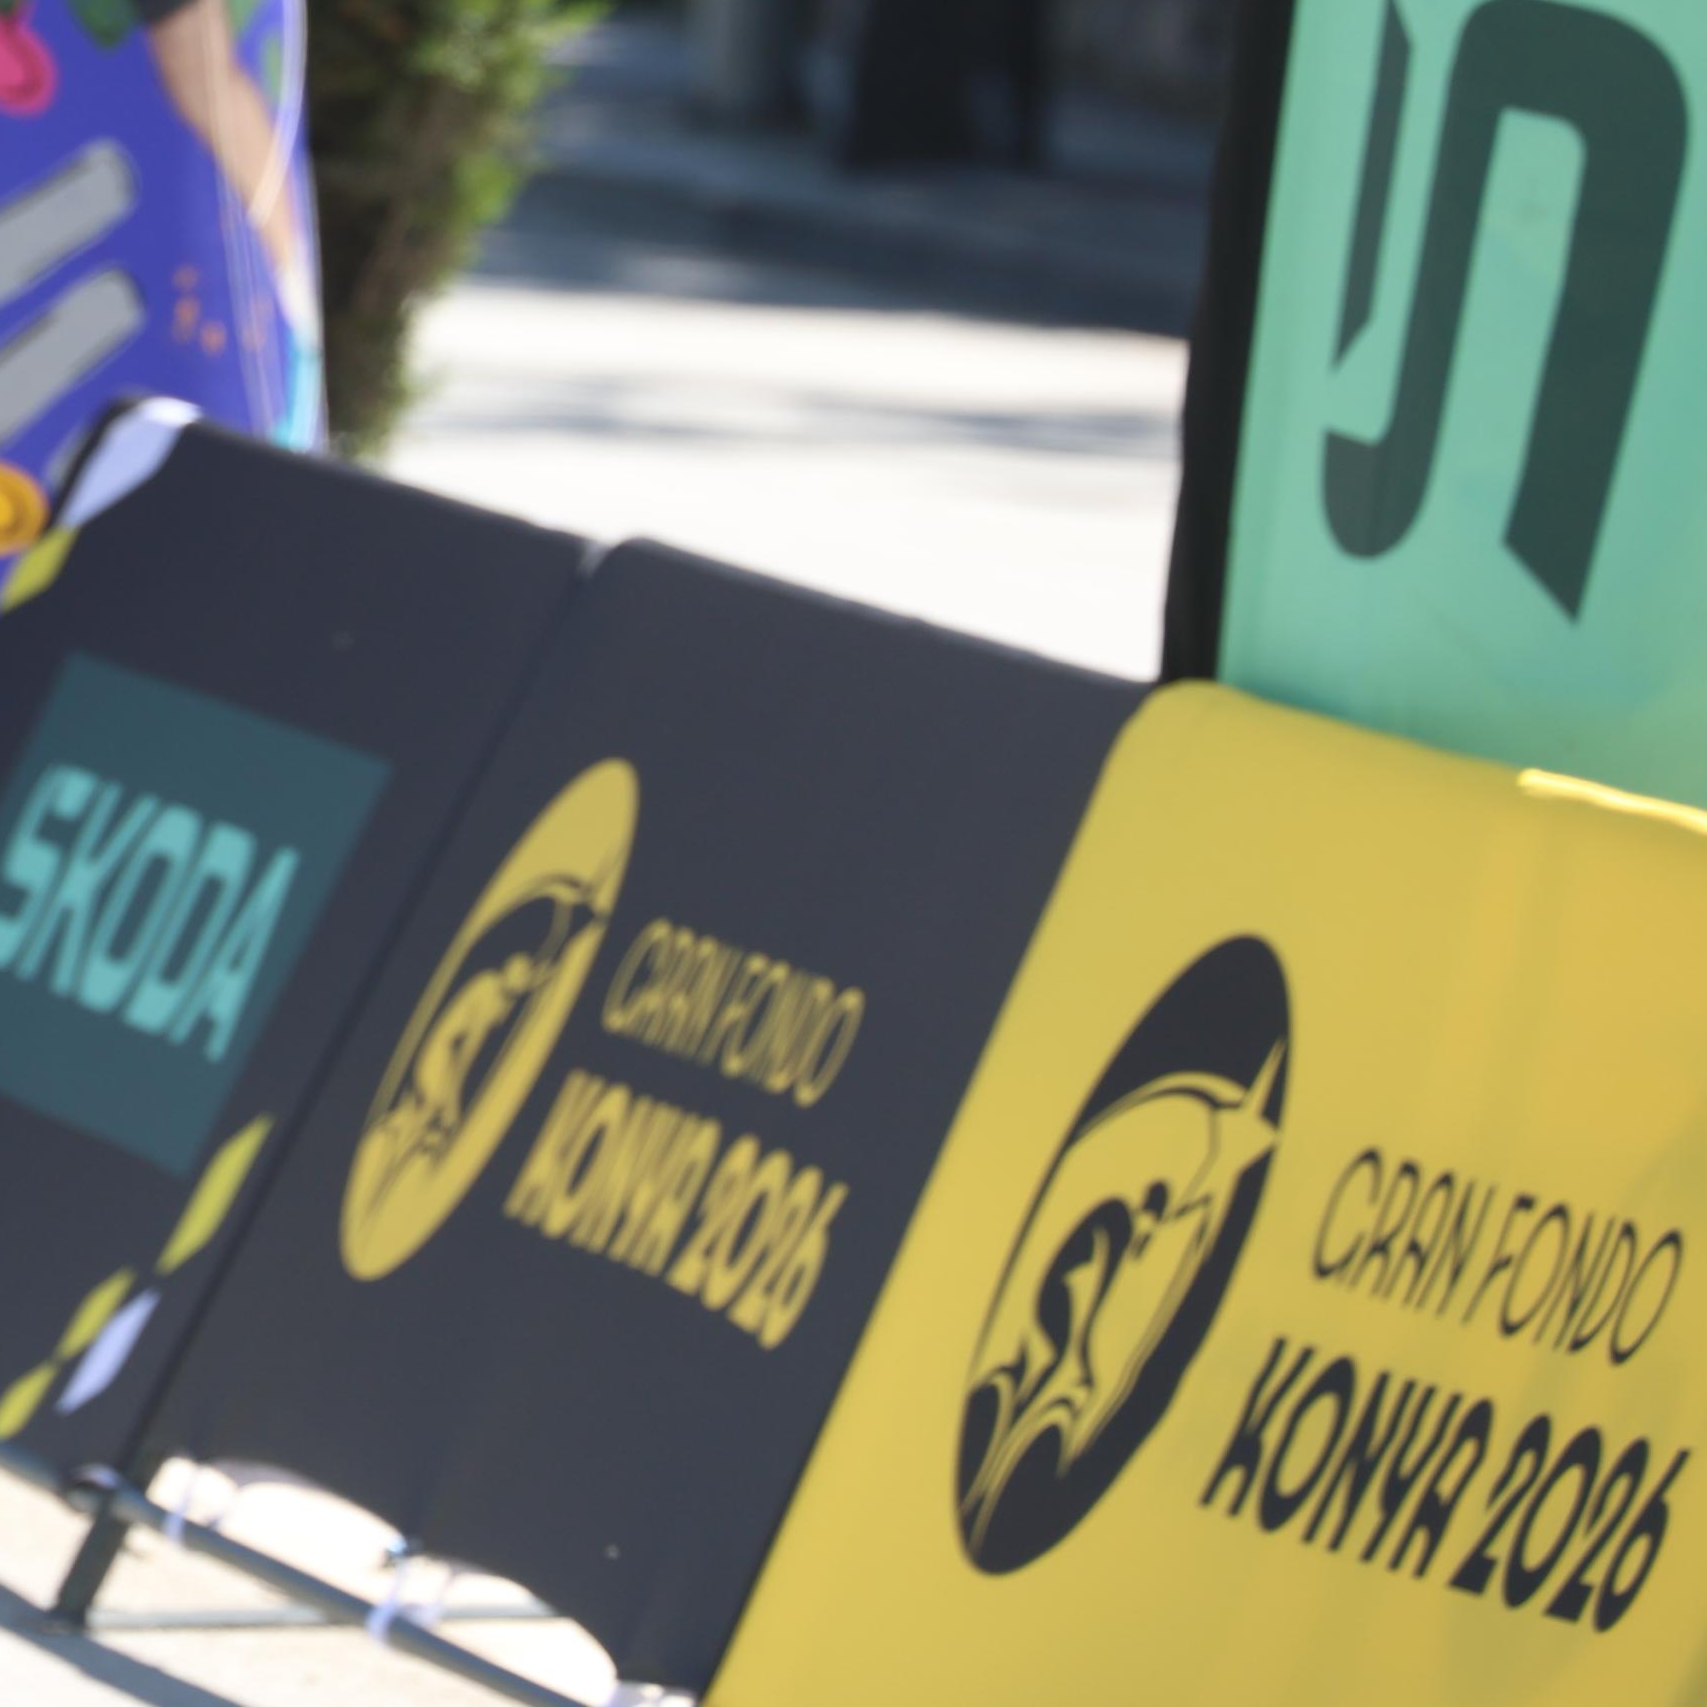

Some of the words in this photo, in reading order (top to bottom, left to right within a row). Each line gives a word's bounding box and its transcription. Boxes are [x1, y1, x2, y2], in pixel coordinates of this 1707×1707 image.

[699, 951, 865, 1109] FONDO
[504, 1068, 722, 1277] KONYA
[665, 1134, 850, 1351] 2026
[1313, 1146, 1496, 1320] GRAN
[1462, 1192, 1684, 1366] FONDO
[1198, 1335, 1494, 1581] KONYA
[1446, 1413, 1692, 1635] 2026
